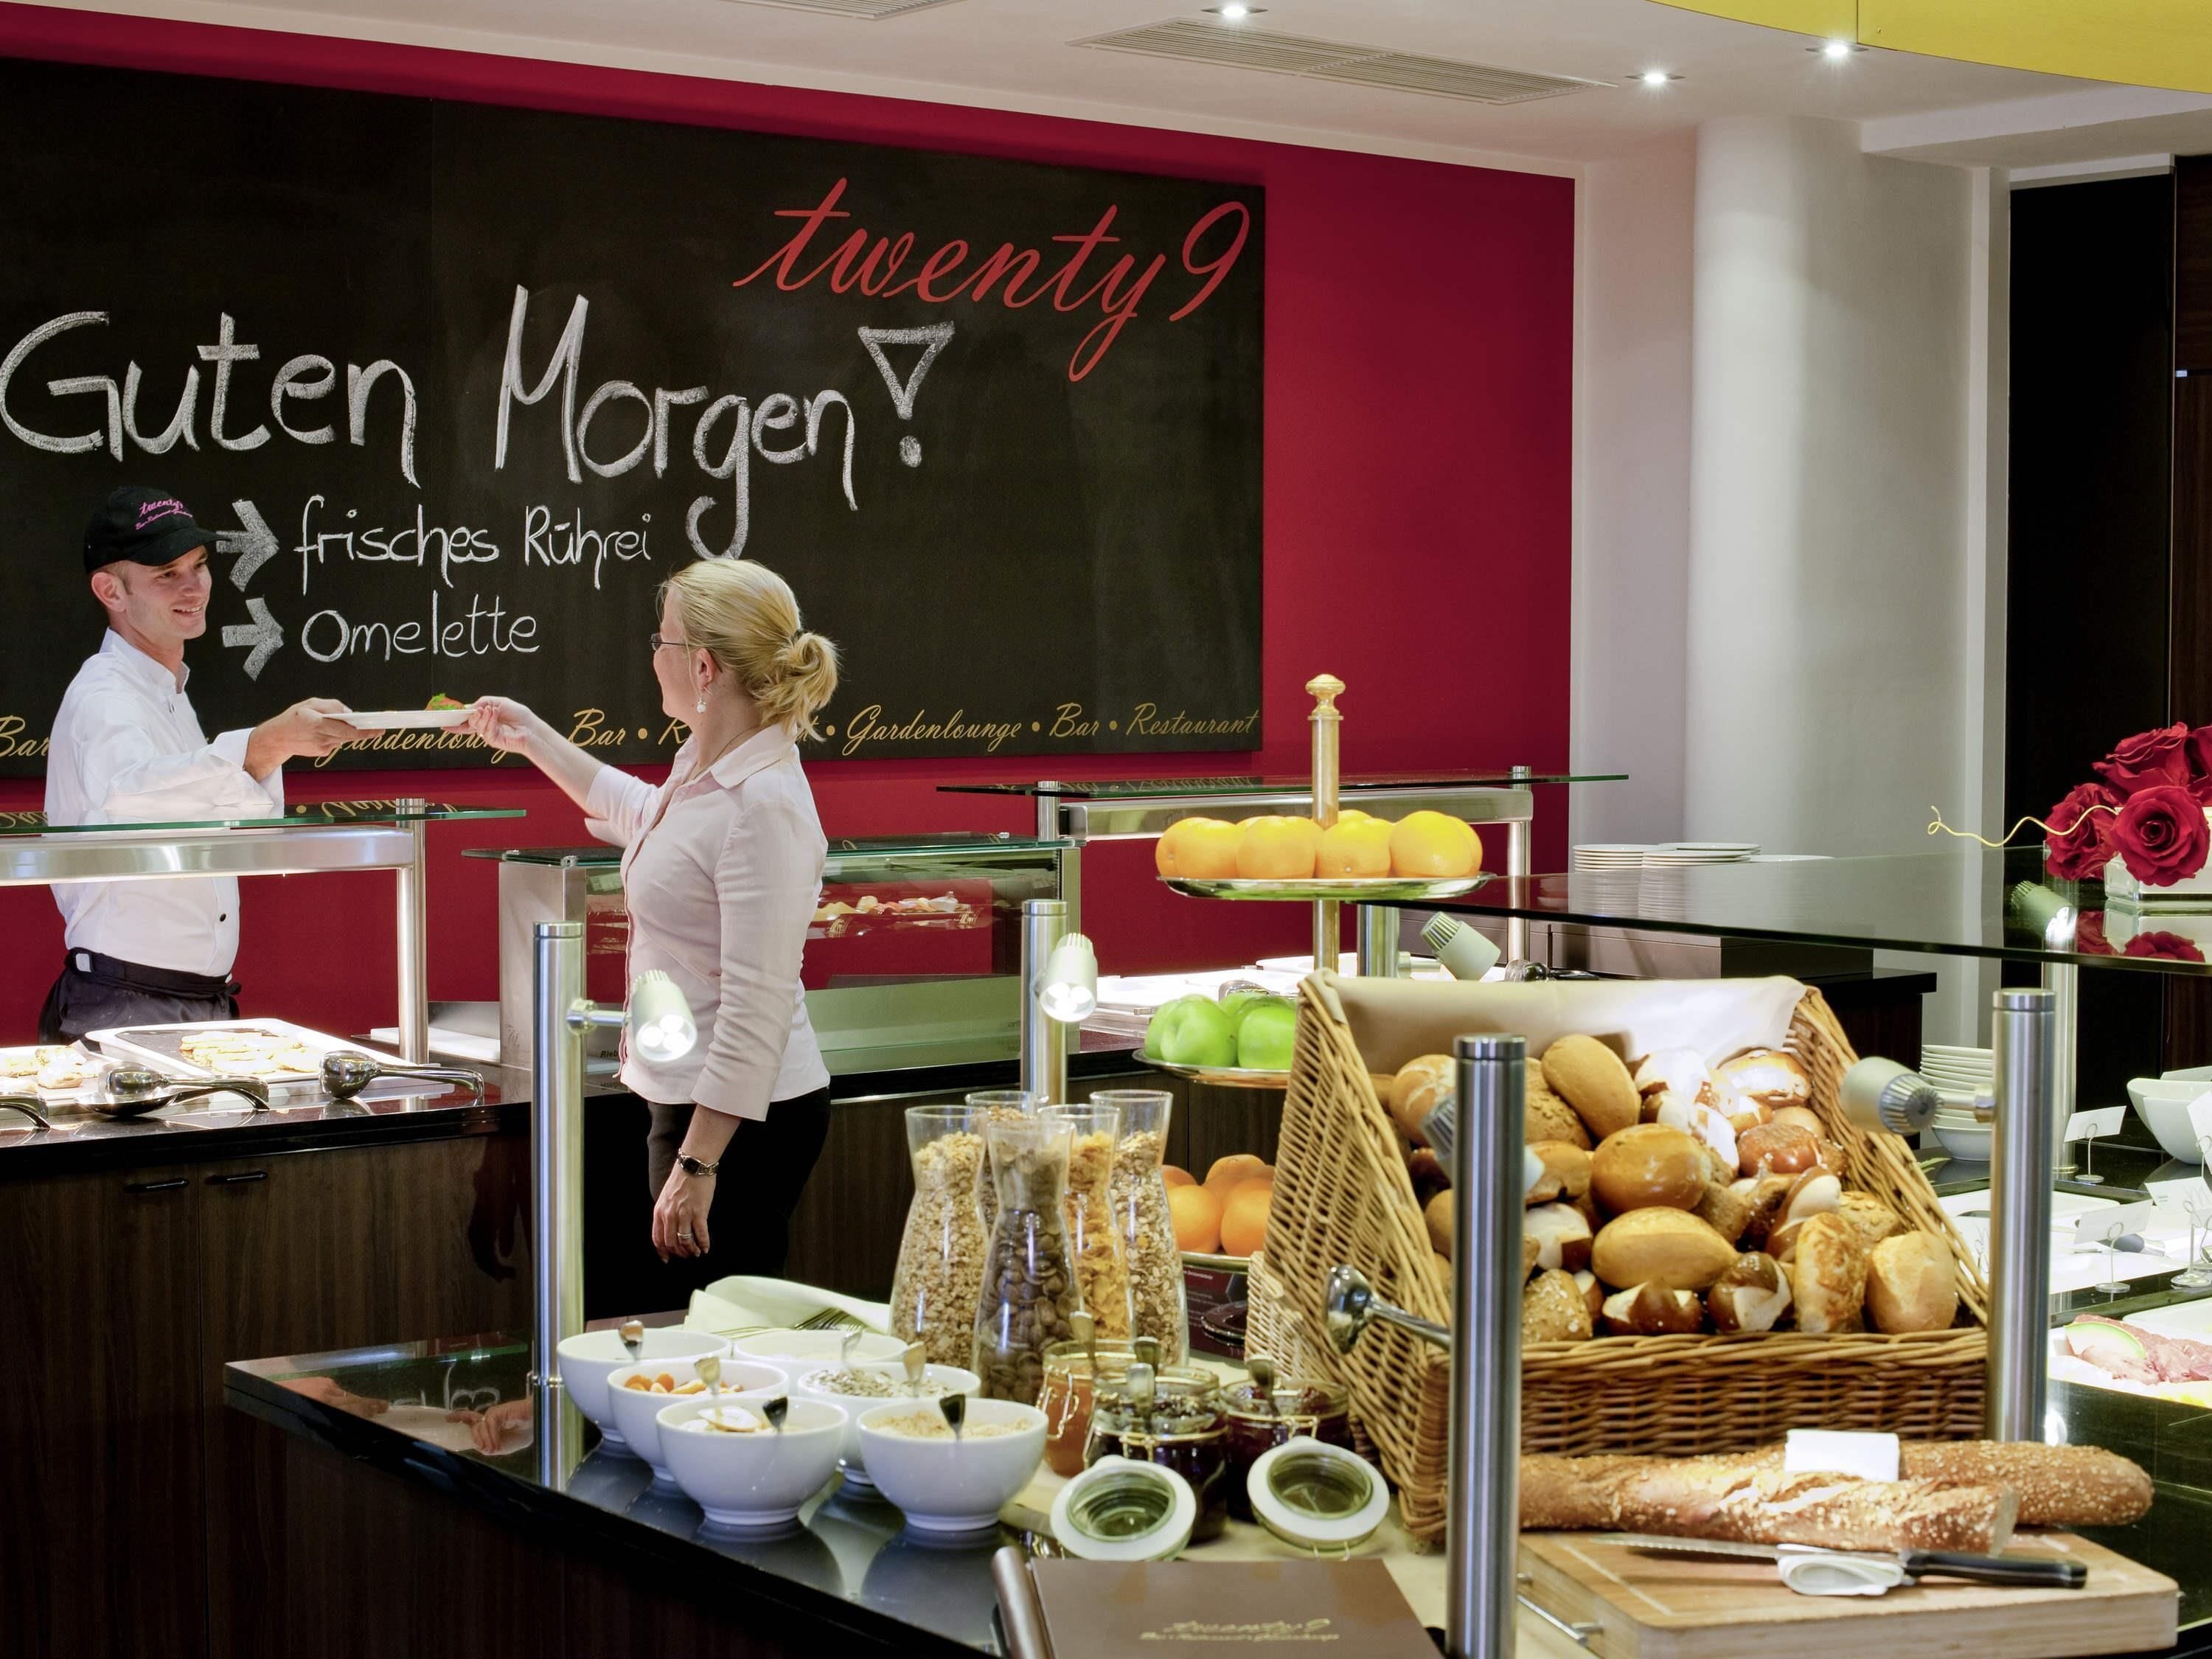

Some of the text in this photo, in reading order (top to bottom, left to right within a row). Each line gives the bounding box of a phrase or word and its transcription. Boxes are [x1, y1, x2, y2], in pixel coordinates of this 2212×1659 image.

[0, 310, 420, 488] Guten
[293, 494, 500, 596] frisches
[301, 589, 540, 663] Omelette
[568, 707, 627, 748] Bar
[841, 704, 1022, 756] Gardenlounge
[1049, 702, 1099, 737] Bar
[1125, 702, 1260, 737] Restaurant
